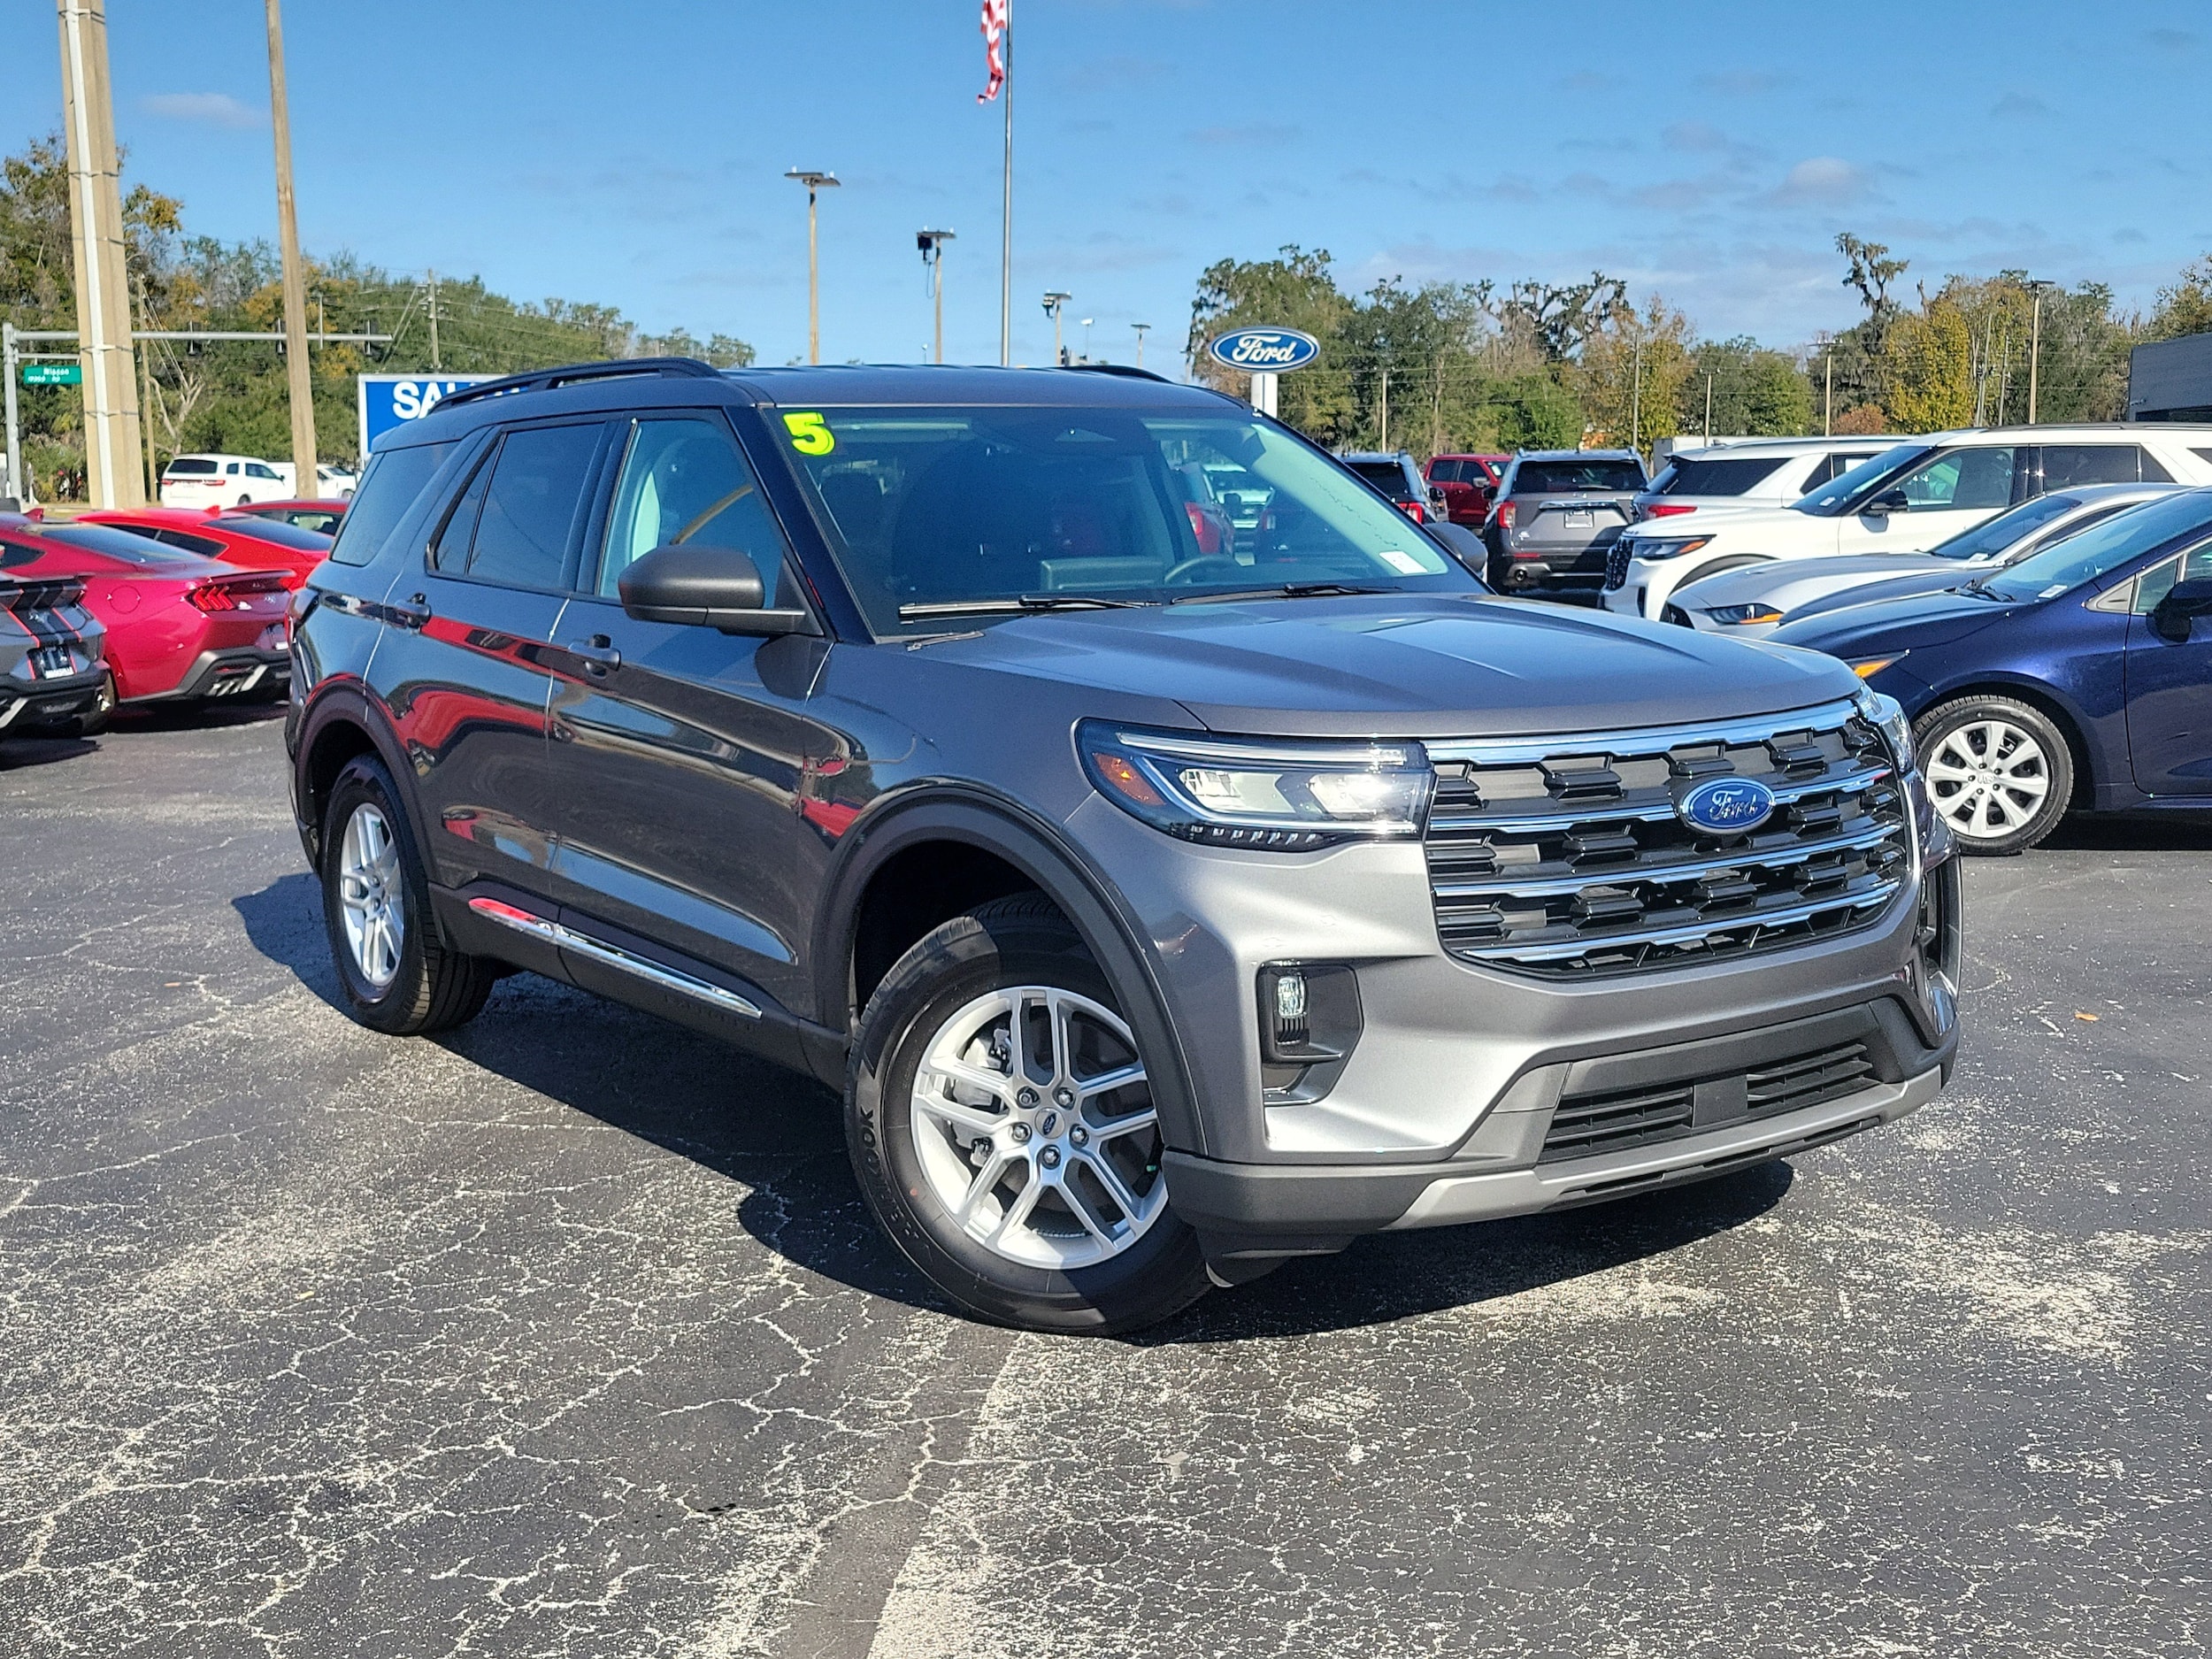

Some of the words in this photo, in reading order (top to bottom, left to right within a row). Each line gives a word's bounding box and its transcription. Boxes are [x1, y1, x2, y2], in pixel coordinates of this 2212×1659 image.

[1232, 334, 1297, 363] Ford
[782, 411, 835, 456] 5
[1709, 788, 1758, 821] Ford
